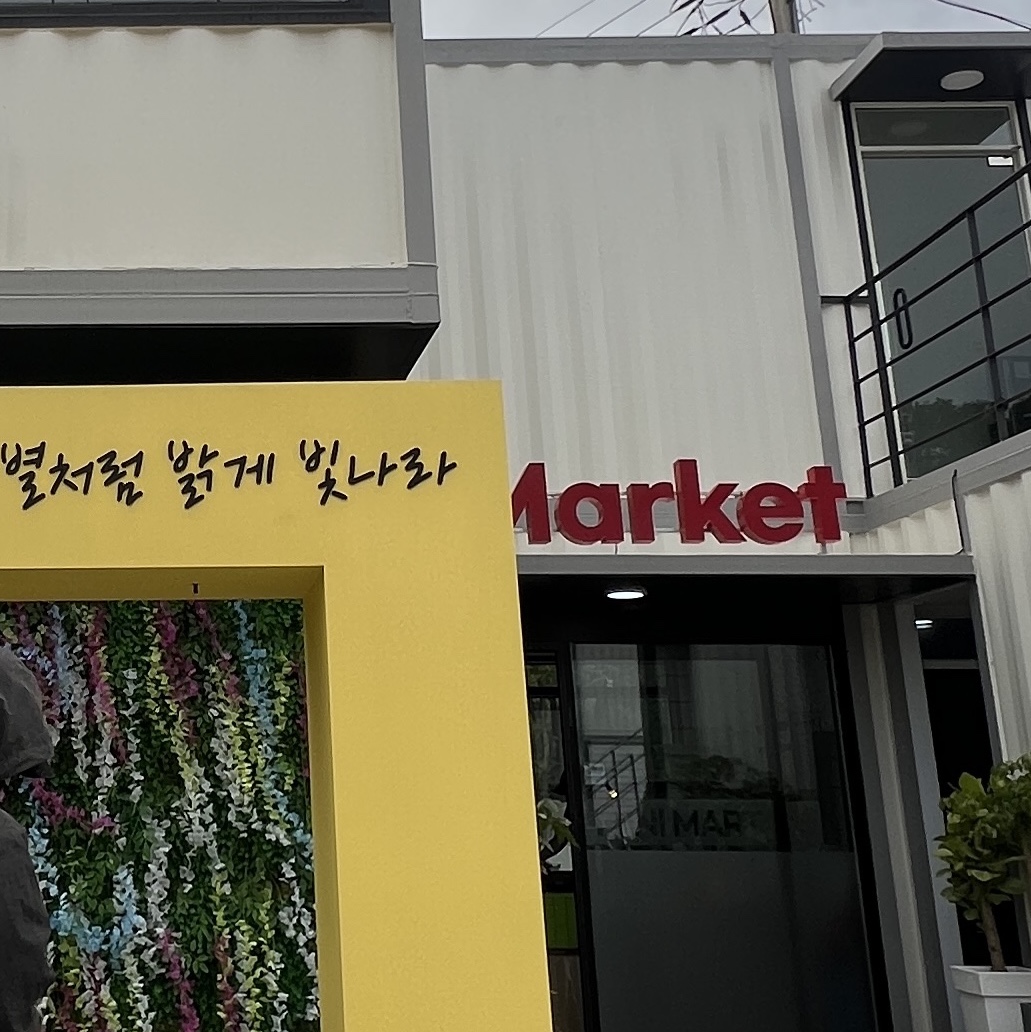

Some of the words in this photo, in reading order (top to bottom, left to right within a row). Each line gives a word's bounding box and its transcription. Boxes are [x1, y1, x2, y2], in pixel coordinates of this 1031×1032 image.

[0, 441, 144, 511] 별처럼
[167, 440, 276, 510] 밝게
[299, 439, 458, 506] 빛나라
